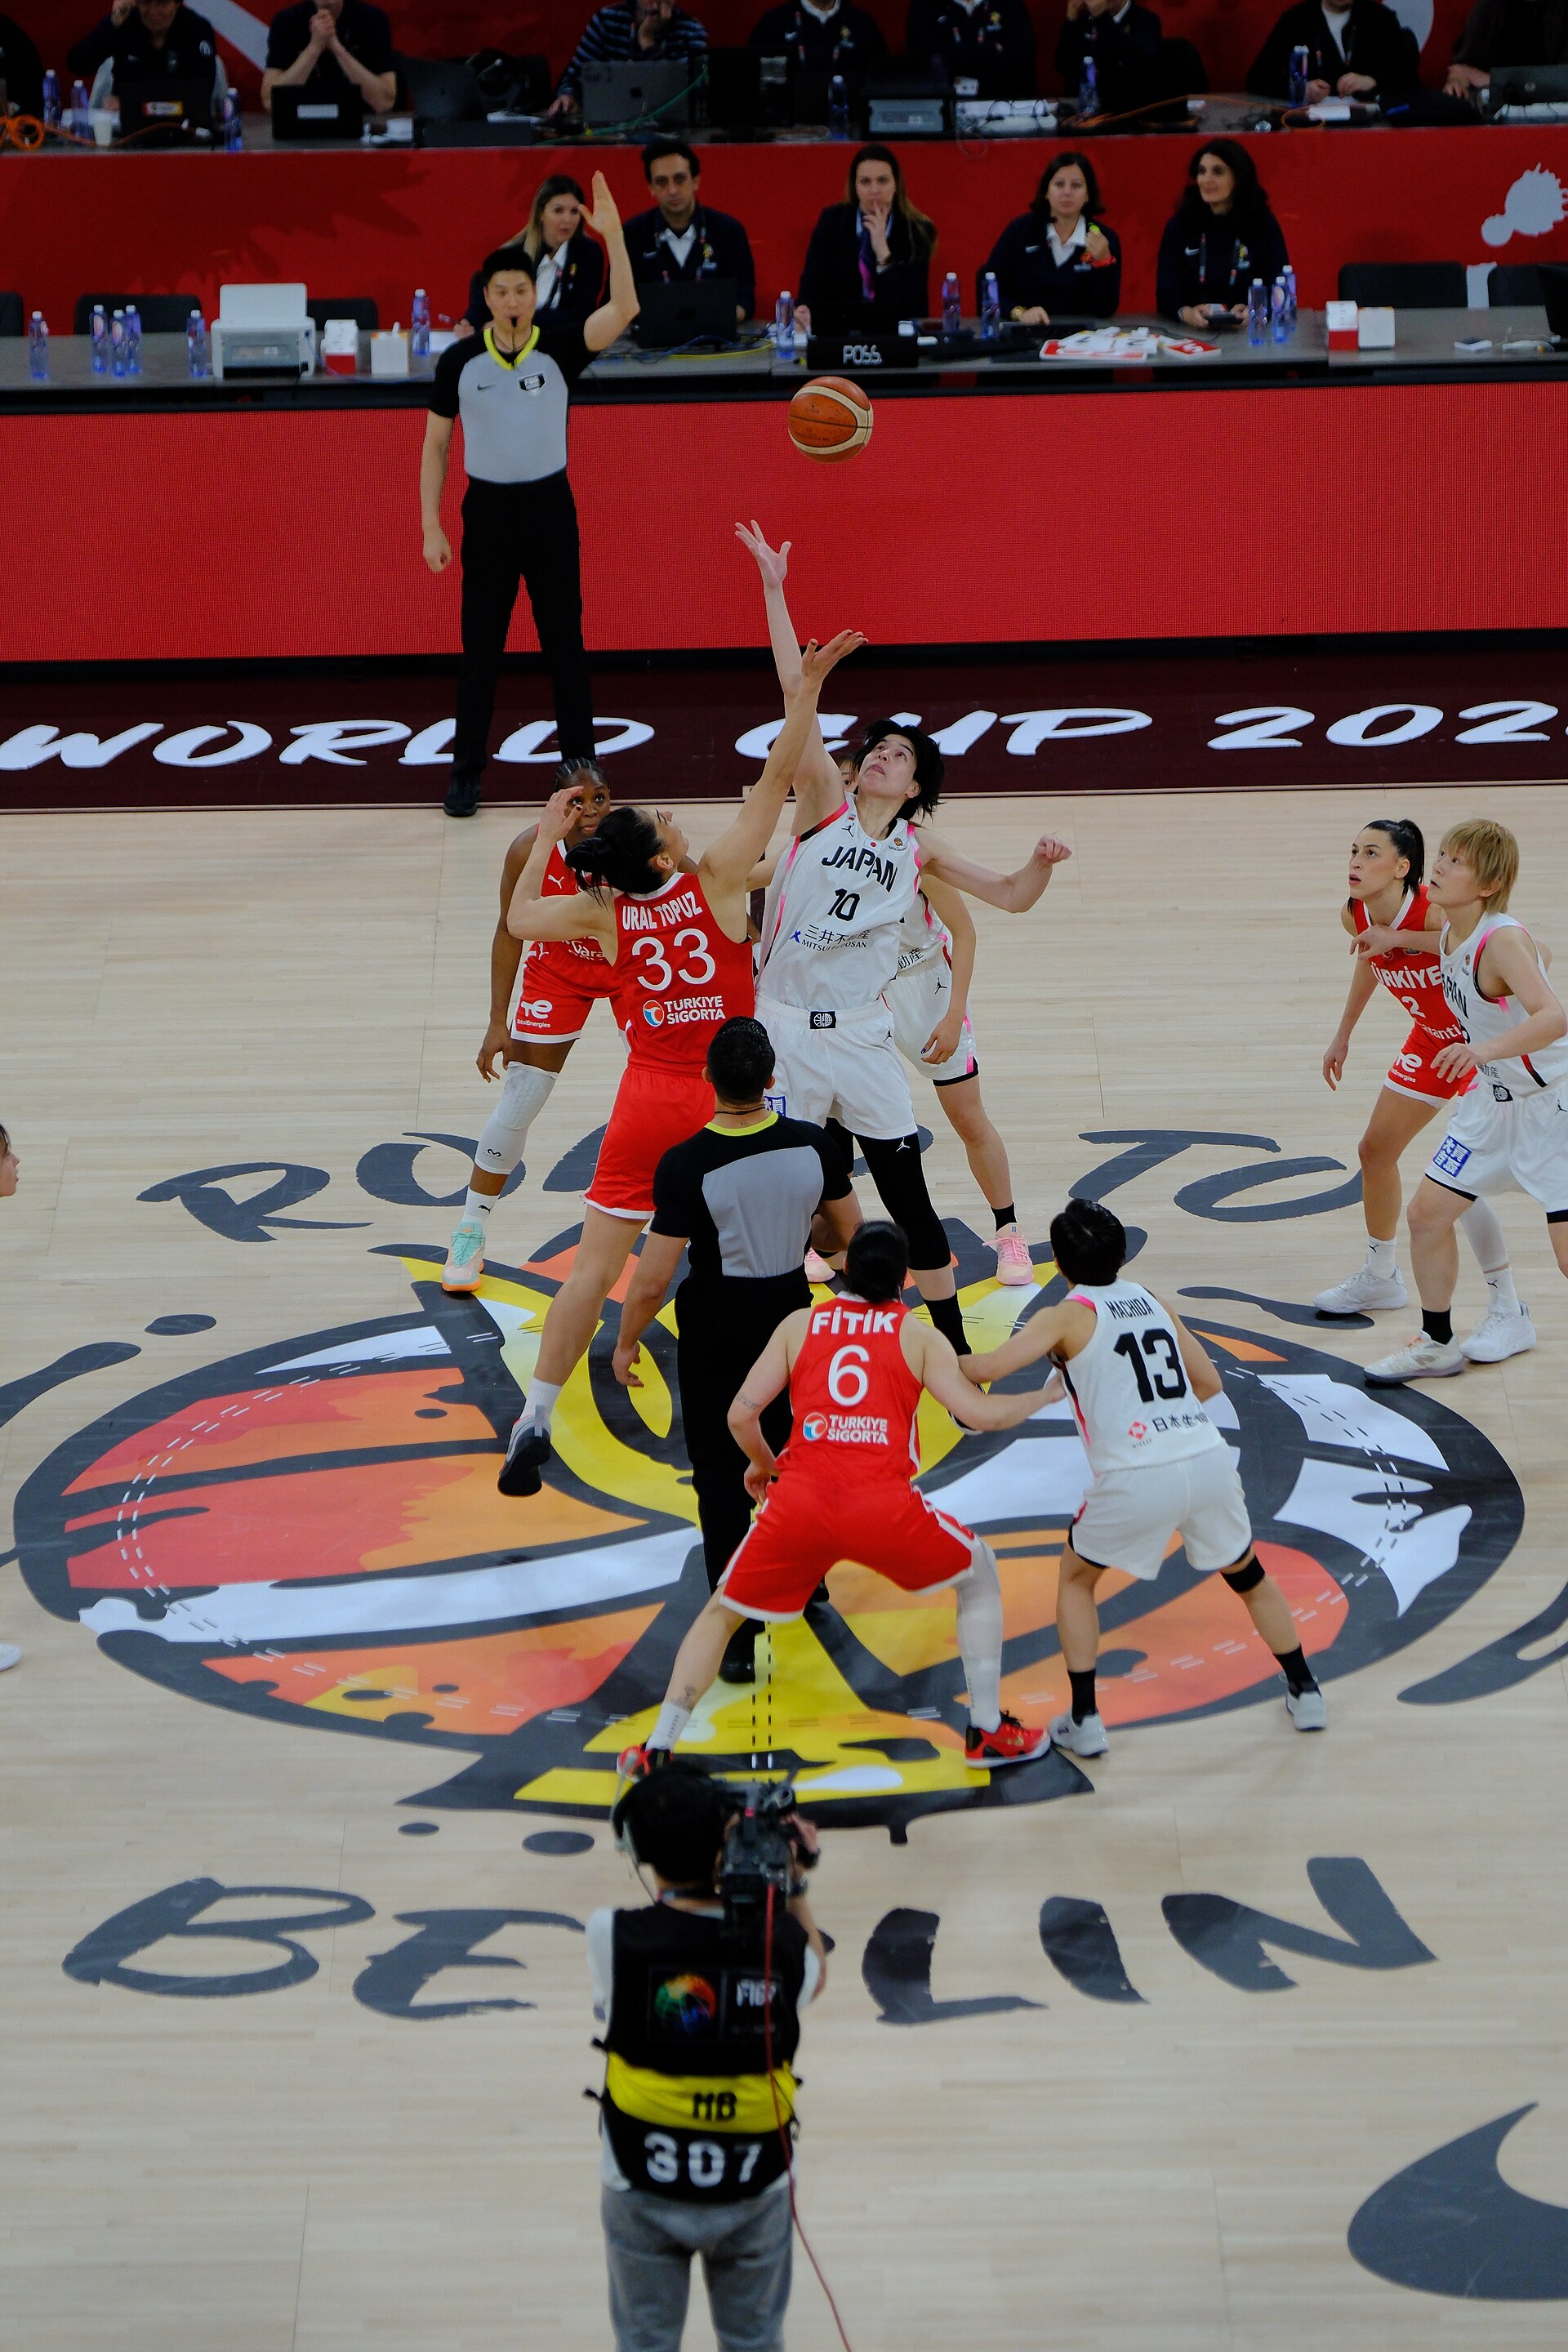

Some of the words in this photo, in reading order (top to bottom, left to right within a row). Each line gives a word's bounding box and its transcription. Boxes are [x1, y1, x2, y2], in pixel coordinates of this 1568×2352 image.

[0, 717, 654, 771] WORLD
[1207, 700, 1568, 751] 202
[821, 846, 898, 892] JAPAN
[622, 906, 657, 930] URAL
[654, 891, 703, 927] TOPUZ
[827, 888, 860, 921] 10
[632, 929, 715, 991] 33
[1370, 961, 1443, 989] ÜRKİYE
[1401, 996, 1426, 1018] 2
[1105, 1297, 1155, 1320] MACHIDA
[828, 1344, 870, 1406] 6
[1113, 1328, 1187, 1403] 13
[62, 1856, 1440, 2026] BELIN
[644, 2132, 763, 2189] 307
